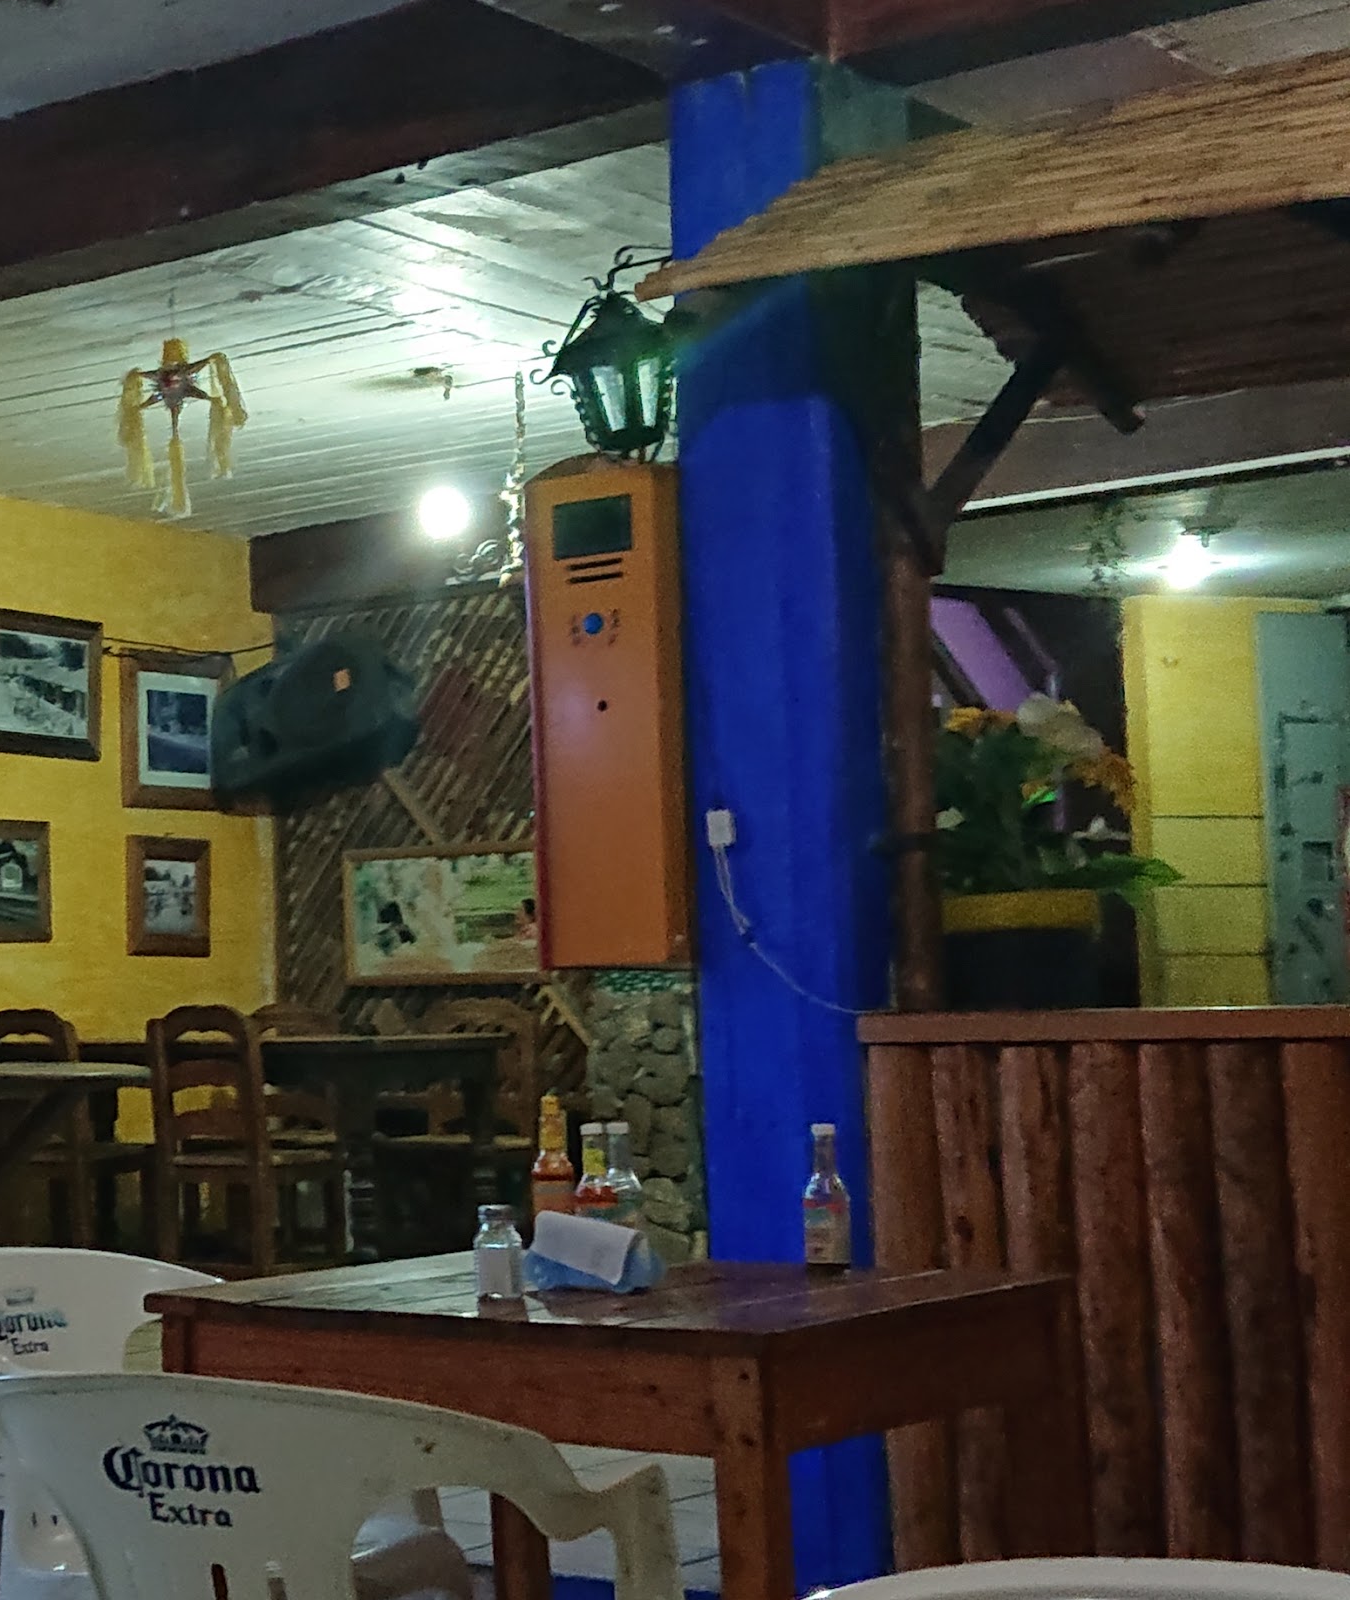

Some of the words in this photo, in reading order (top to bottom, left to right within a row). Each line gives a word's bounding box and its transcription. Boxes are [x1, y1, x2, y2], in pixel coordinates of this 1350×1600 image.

[10, 1338, 50, 1356] Extra
[102, 1445, 261, 1498] Corona
[148, 1492, 233, 1528] Extra
